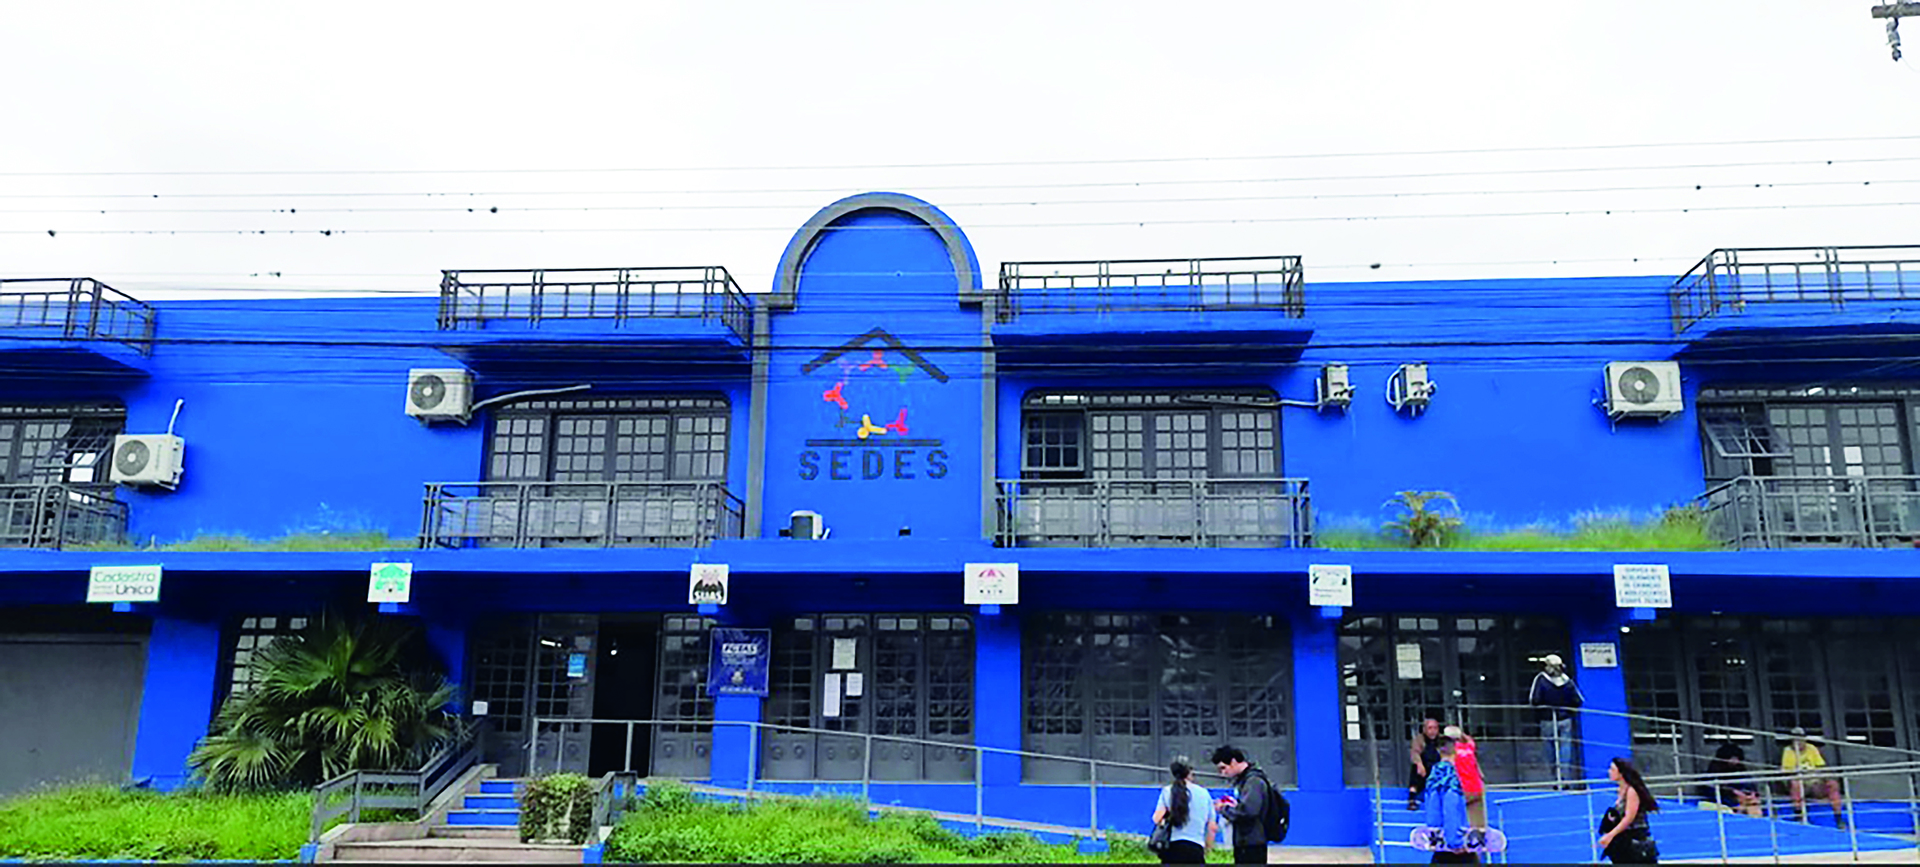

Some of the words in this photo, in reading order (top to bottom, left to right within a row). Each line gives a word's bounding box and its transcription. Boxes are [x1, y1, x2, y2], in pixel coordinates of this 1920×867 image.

[799, 450, 948, 480] SEDES
[95, 571, 155, 582] Cadastro
[694, 590, 722, 601] SUAS
